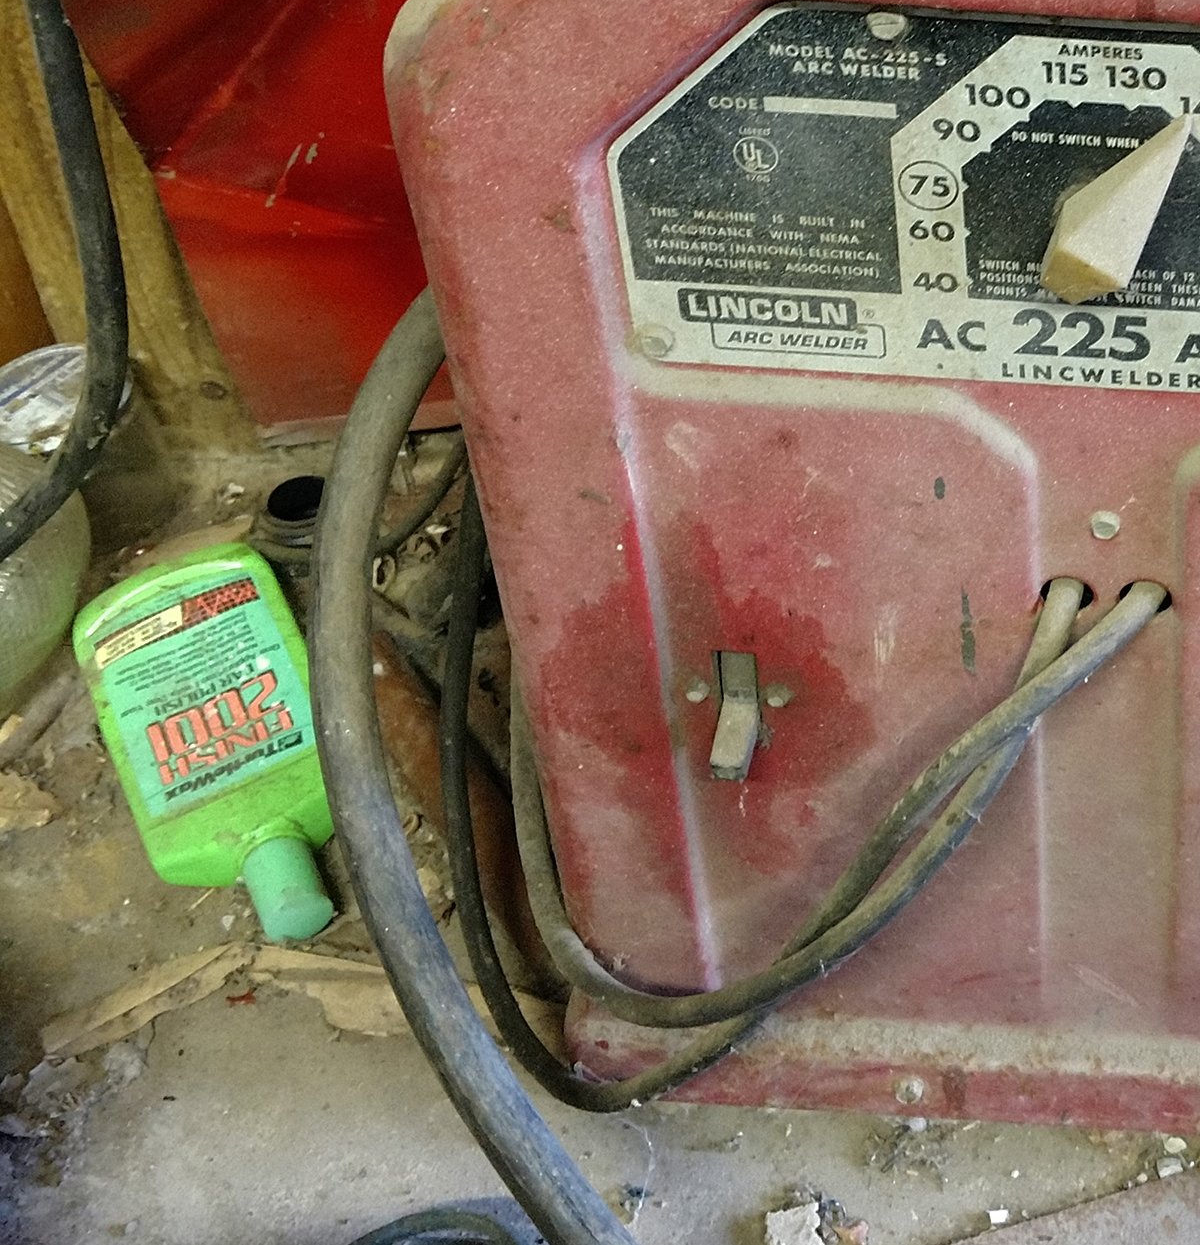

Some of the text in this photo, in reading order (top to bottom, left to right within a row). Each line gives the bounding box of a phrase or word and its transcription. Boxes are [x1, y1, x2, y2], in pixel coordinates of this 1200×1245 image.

[769, 44, 834, 59] MODEL
[1058, 43, 1143, 60] AMPERES
[792, 61, 921, 81] ARC WELDER
[1041, 61, 1167, 91] 115 130
[708, 96, 759, 110] CODE
[964, 83, 1031, 109] 100
[932, 118, 981, 142] 90
[1011, 130, 1028, 142] DO
[1031, 132, 1053, 144] NOT
[1058, 133, 1101, 147] SWITCH
[1106, 136, 1139, 149] WHEN
[908, 174, 949, 198] 75
[650, 207, 865, 229] THIS MACHINE IS BUILT IN
[661, 224, 860, 245] ACCORDANCE WITH NEMA
[909, 219, 955, 242] 60
[645, 239, 725, 254] STANDARDS
[808, 247, 882, 262] ELECTRICAL
[655, 256, 771, 271] MANUFACTURERS
[978, 259, 1020, 272] SWITCH
[913, 272, 959, 293] 40
[1135, 269, 1156, 281] ACH
[1163, 272, 1176, 282] OF
[1184, 272, 1195, 282] 12
[986, 285, 1028, 298] POINTS
[1117, 293, 1162, 306] SWITCH
[687, 293, 848, 327] LINCOLN
[727, 330, 868, 351] ARC WELDER
[916, 318, 987, 352] AC
[1012, 308, 1150, 362] 225
[155, 683, 217, 716] POLISH
[146, 670, 284, 762] 2001
[158, 708, 294, 786] FINISH
